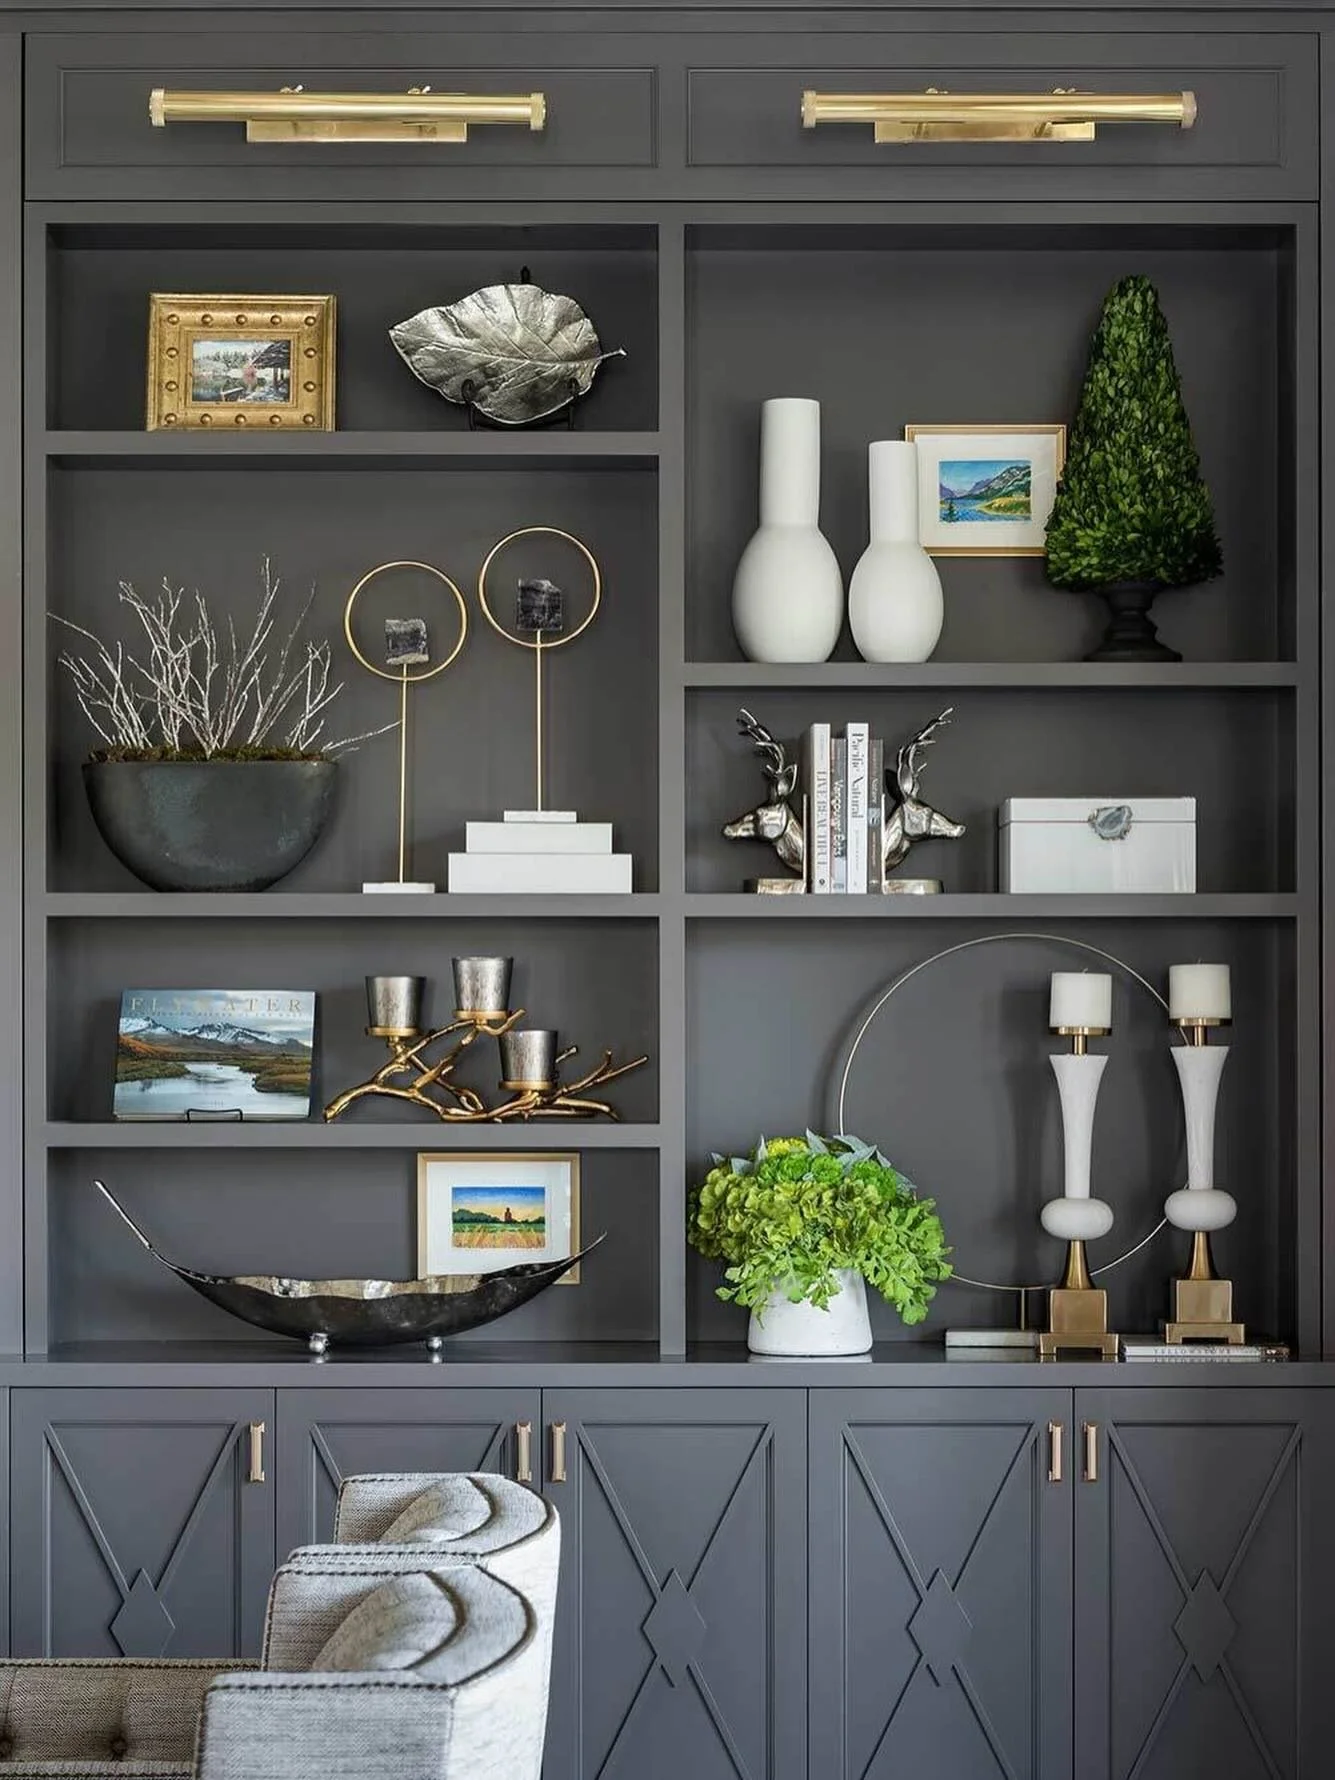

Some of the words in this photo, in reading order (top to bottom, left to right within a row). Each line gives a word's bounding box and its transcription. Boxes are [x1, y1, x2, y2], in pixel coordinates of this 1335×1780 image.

[851, 733, 864, 771] Pacific
[817, 771, 828, 797] LIVE
[851, 776, 864, 818] Natural
[833, 779, 844, 832] Vancouver
[817, 800, 828, 868] BEAUTIFUL
